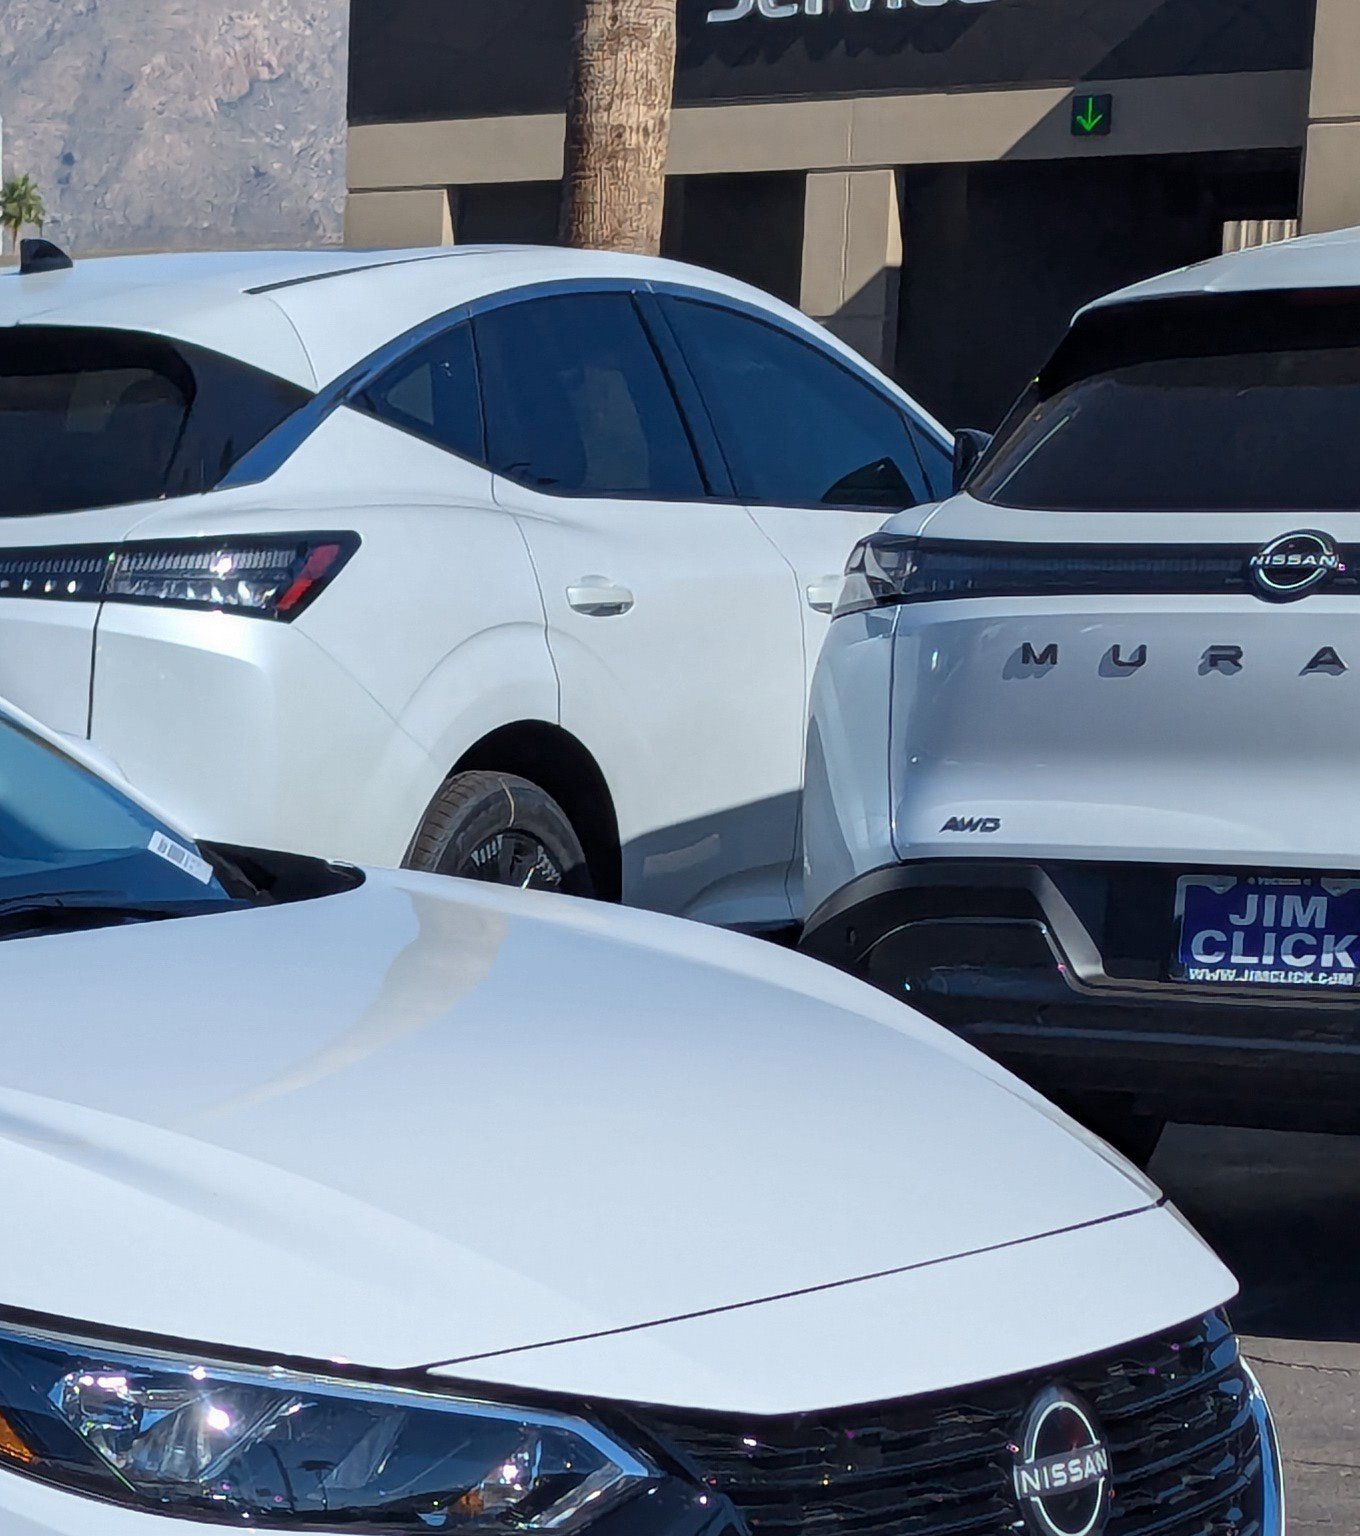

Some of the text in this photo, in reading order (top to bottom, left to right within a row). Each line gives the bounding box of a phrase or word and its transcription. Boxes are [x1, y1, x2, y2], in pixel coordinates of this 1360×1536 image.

[1249, 554, 1339, 568] NISSAN
[1021, 642, 1349, 672] MURA
[939, 816, 1001, 833] AWD
[1229, 894, 1328, 929] JIM
[1191, 929, 1358, 969] CLICK
[1020, 1448, 1109, 1494] NISSAN
